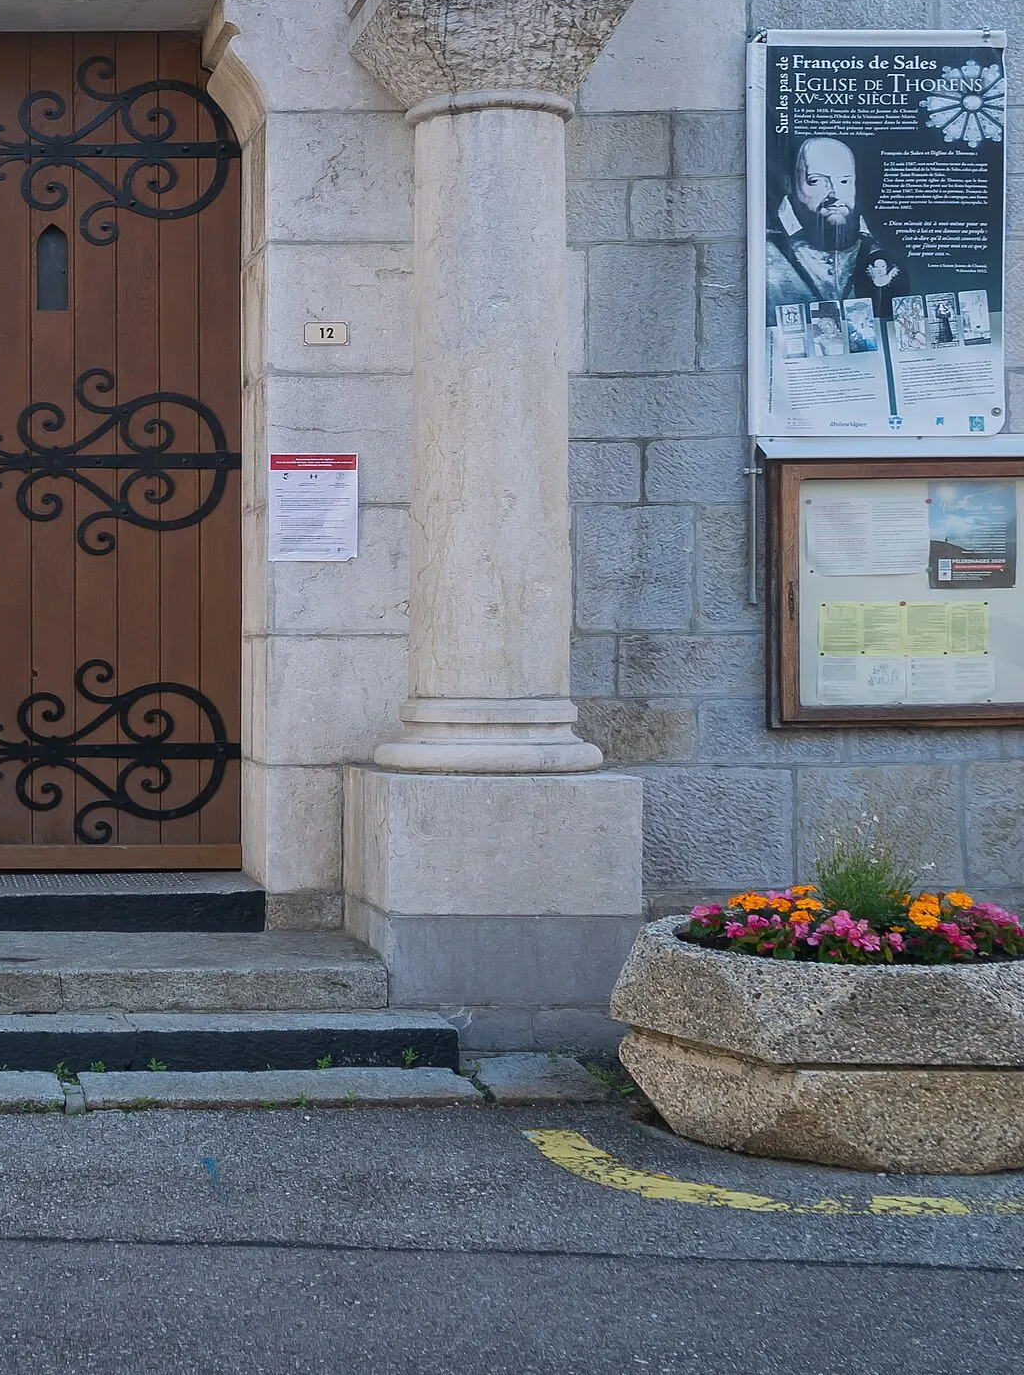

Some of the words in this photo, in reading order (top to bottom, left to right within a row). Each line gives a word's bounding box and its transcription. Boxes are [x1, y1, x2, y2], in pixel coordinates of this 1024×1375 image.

[775, 56, 788, 70] de
[792, 54, 864, 73] François
[868, 55, 890, 70] de
[893, 54, 938, 70] Sales
[779, 73, 792, 93] pas
[775, 94, 788, 111] les
[857, 91, 909, 105] SIÈCLE
[776, 112, 789, 134] Sur
[320, 328, 334, 338] 12
